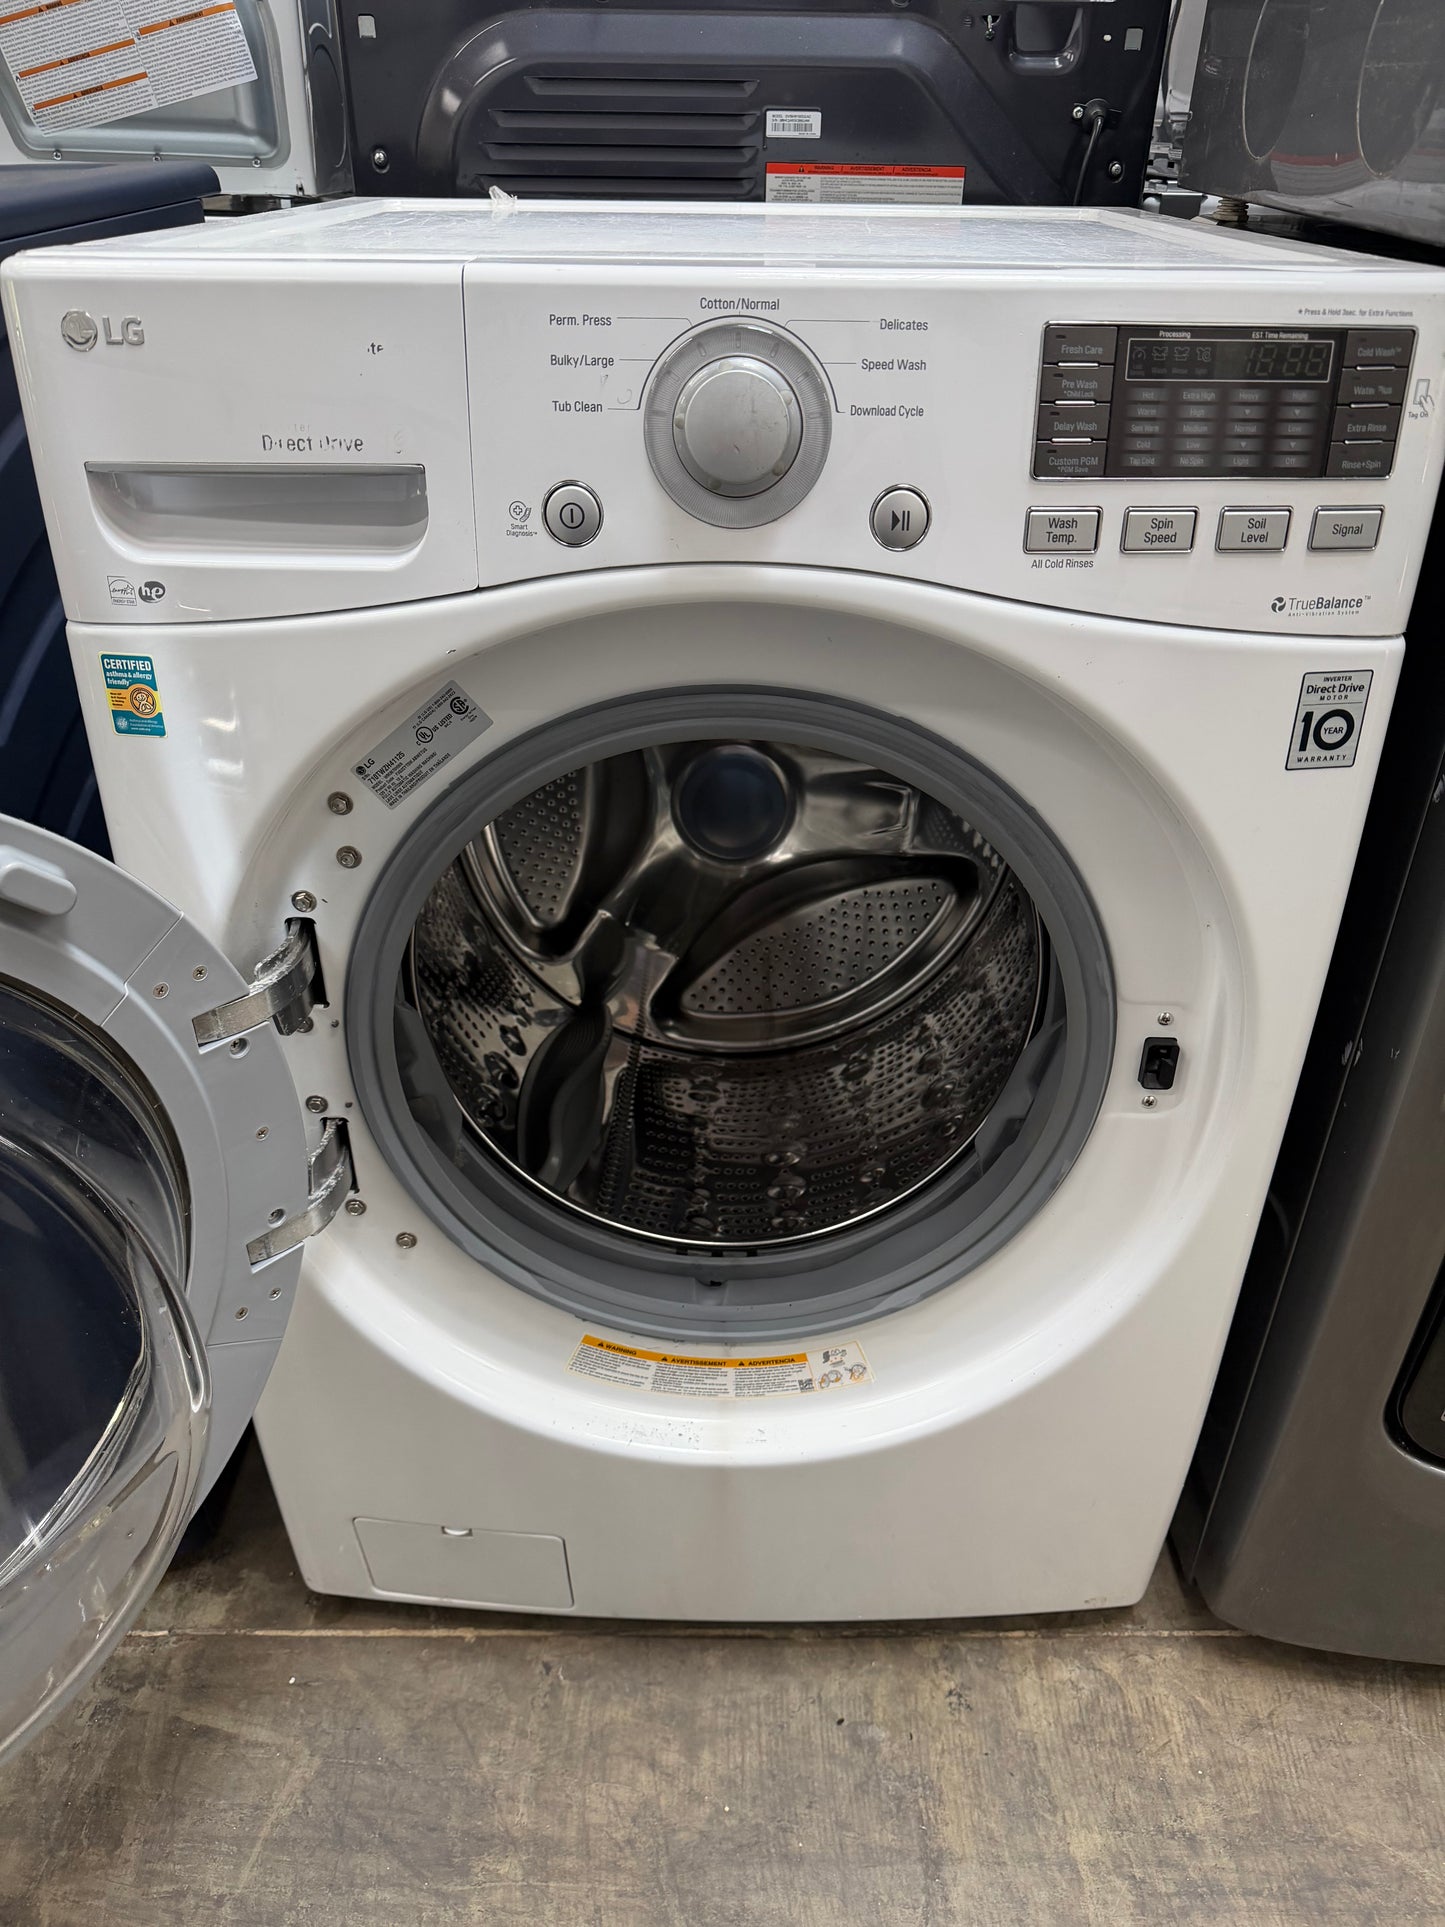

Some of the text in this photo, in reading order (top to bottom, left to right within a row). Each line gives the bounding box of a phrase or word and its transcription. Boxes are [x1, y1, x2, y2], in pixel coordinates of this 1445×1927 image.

[700, 297, 780, 311] Cotton/Normal
[549, 314, 612, 326] Perm. Press
[880, 318, 928, 330] Delicates
[102, 316, 144, 345] LG
[1061, 345, 1103, 354] Fresh Care
[550, 354, 614, 368] Bulky/Large
[861, 359, 926, 372] Speed Wash
[1062, 380, 1098, 389] Pre Wash
[552, 401, 602, 412] Tub Clean
[850, 405, 924, 418] Download Cycle
[1054, 422, 1097, 432] Delay Wash
[1049, 457, 1098, 465] Custom PGM
[1048, 518, 1078, 529] Wash
[1150, 518, 1174, 530] Spin
[1248, 518, 1267, 529] Soil
[1332, 523, 1363, 537] Signal
[1046, 532, 1077, 545] Temp.
[1144, 532, 1177, 544] Speed
[1240, 532, 1268, 543] Level
[1031, 559, 1094, 569] All Cold Rinses
[104, 658, 151, 671] CERTIFIED
[1306, 684, 1364, 694] Direct Drive
[438, 713, 453, 727] LISTED
[1299, 709, 1354, 752] 10
[364, 758, 375, 768] LG
[606, 1343, 637, 1356] WARNING
[671, 1358, 727, 1366] AVERTISSEMENT
[748, 1358, 795, 1366] ADVERTENCIA
